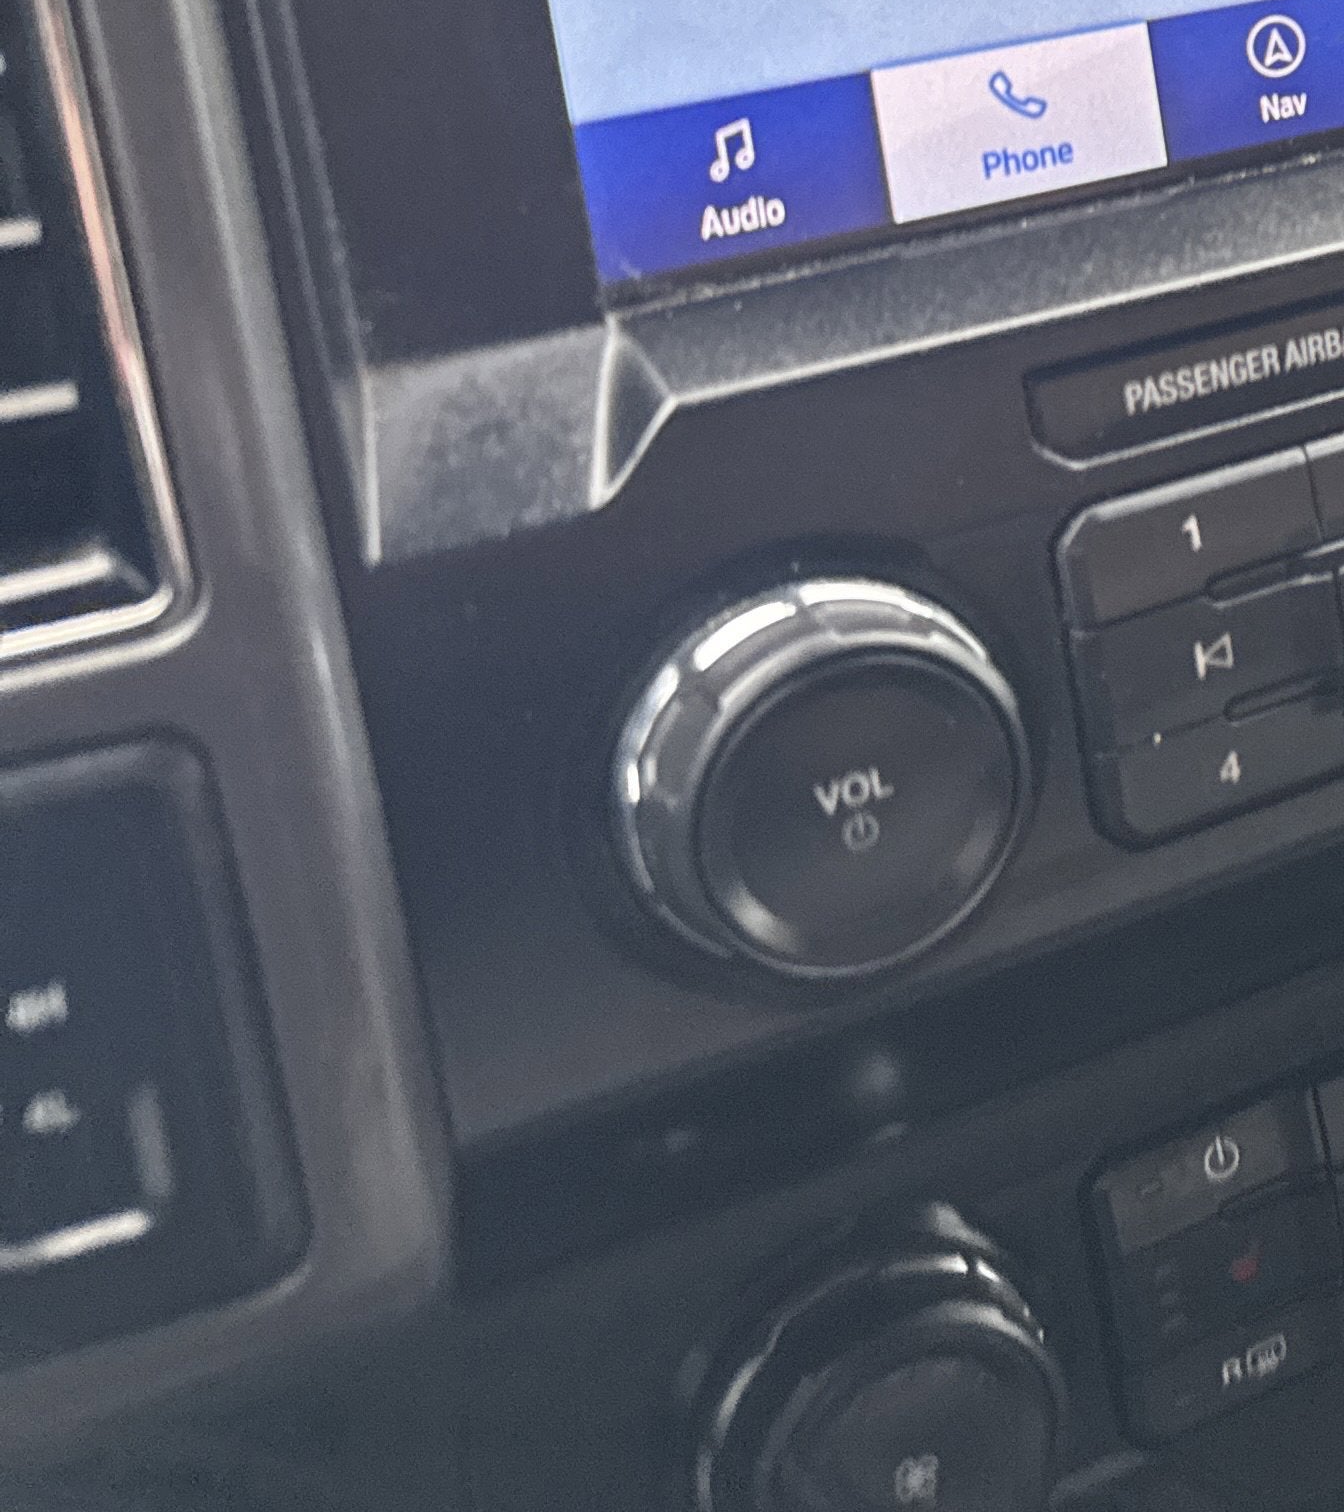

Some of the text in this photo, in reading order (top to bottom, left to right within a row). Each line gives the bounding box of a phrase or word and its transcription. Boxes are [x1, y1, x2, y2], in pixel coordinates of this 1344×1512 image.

[1260, 92, 1308, 124] Nav
[981, 141, 1074, 180] Phone
[701, 195, 786, 241] Audio
[1123, 343, 1281, 417] PASSENGER
[1181, 514, 1202, 551] 1
[1219, 750, 1241, 784] 4
[813, 766, 894, 816] VOL
